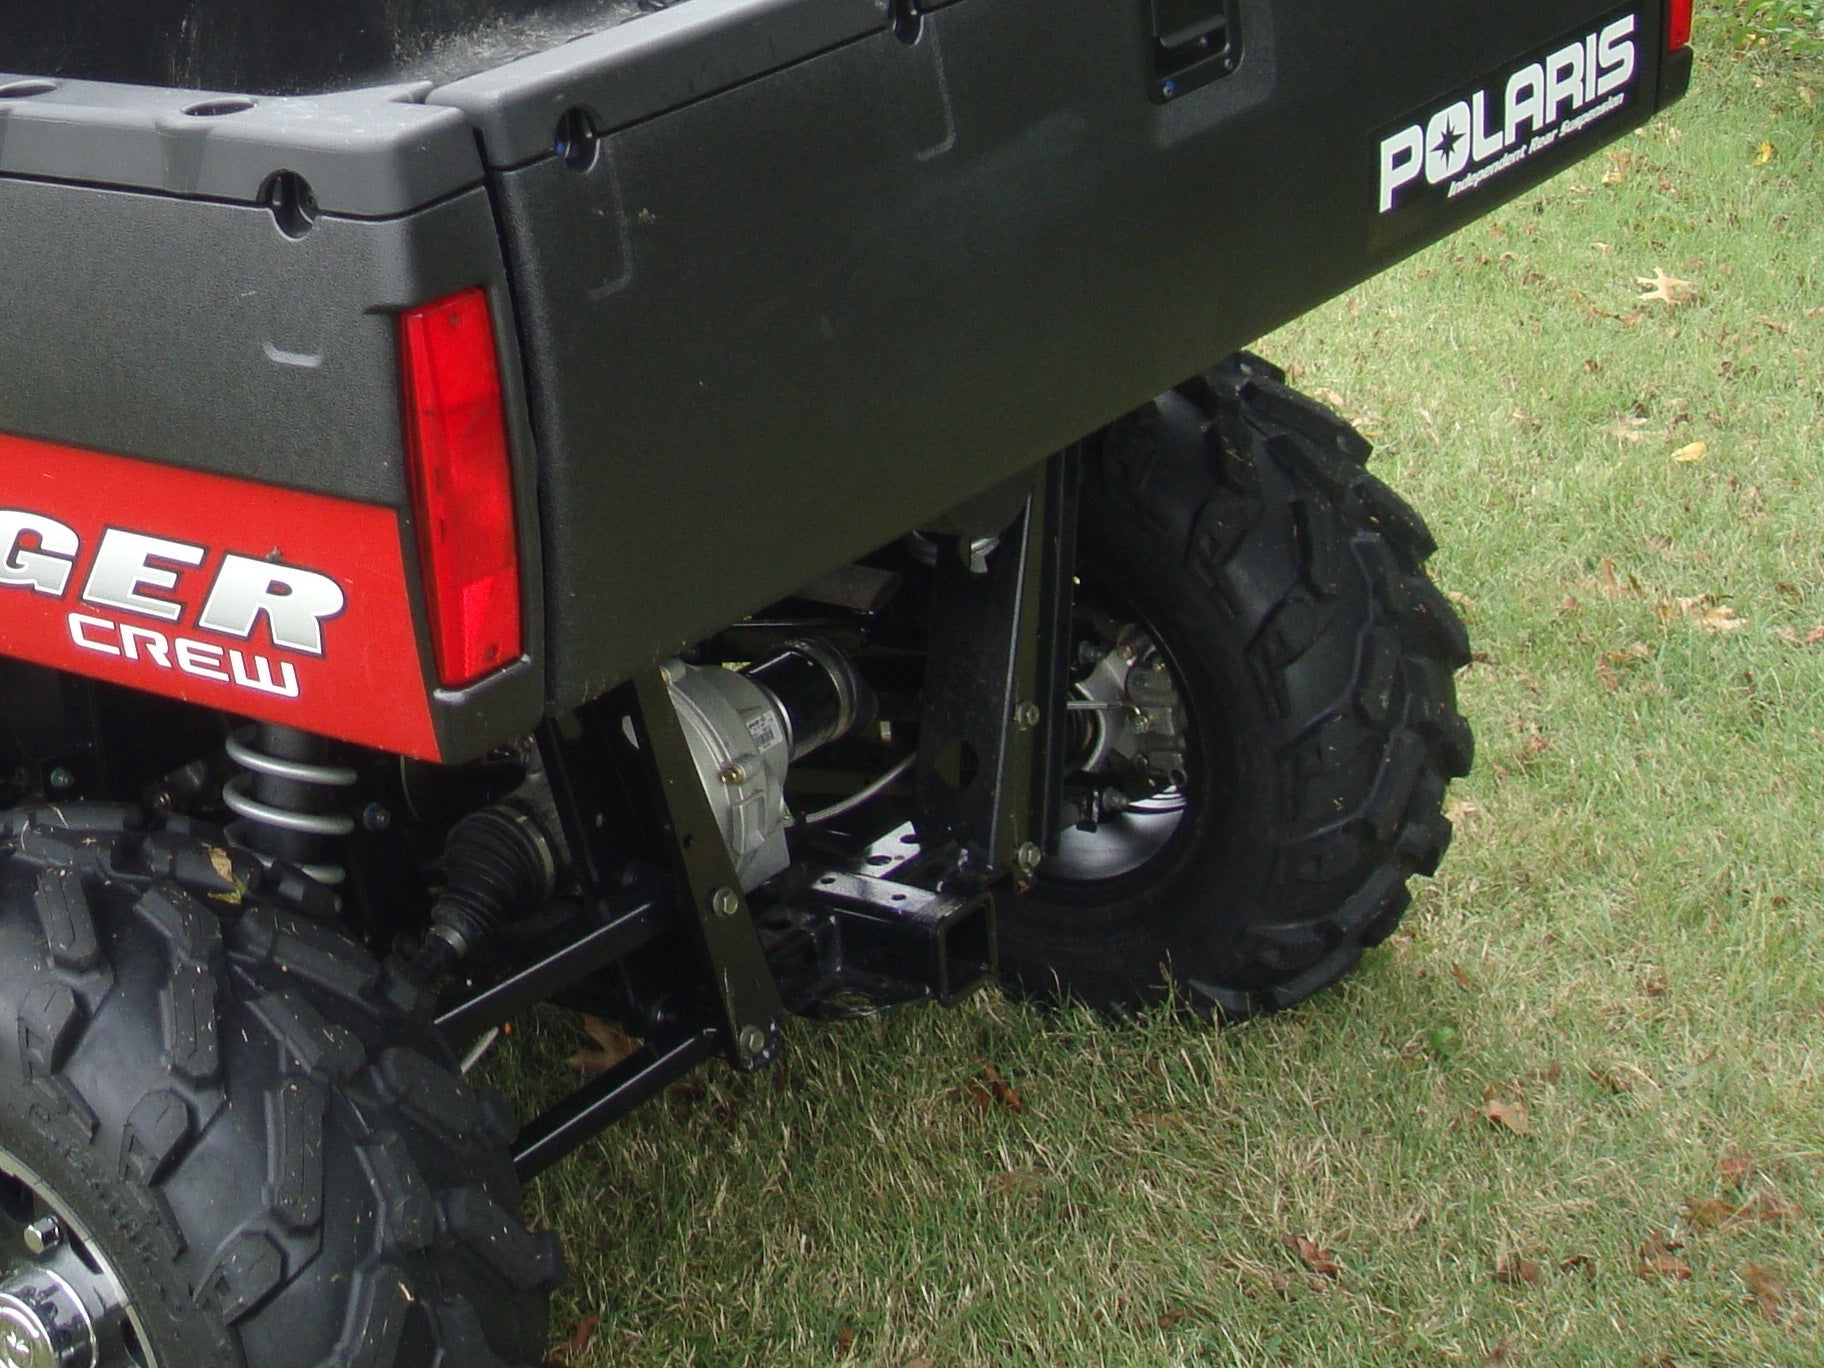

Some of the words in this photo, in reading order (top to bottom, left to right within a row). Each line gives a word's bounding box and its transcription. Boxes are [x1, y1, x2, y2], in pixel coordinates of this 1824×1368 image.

[1379, 13, 1635, 213] POLARIS
[1447, 144, 1528, 199] Independent
[1528, 128, 1559, 155] Rear
[1558, 92, 1625, 138] Suspension
[68, 613, 299, 699] CREW
